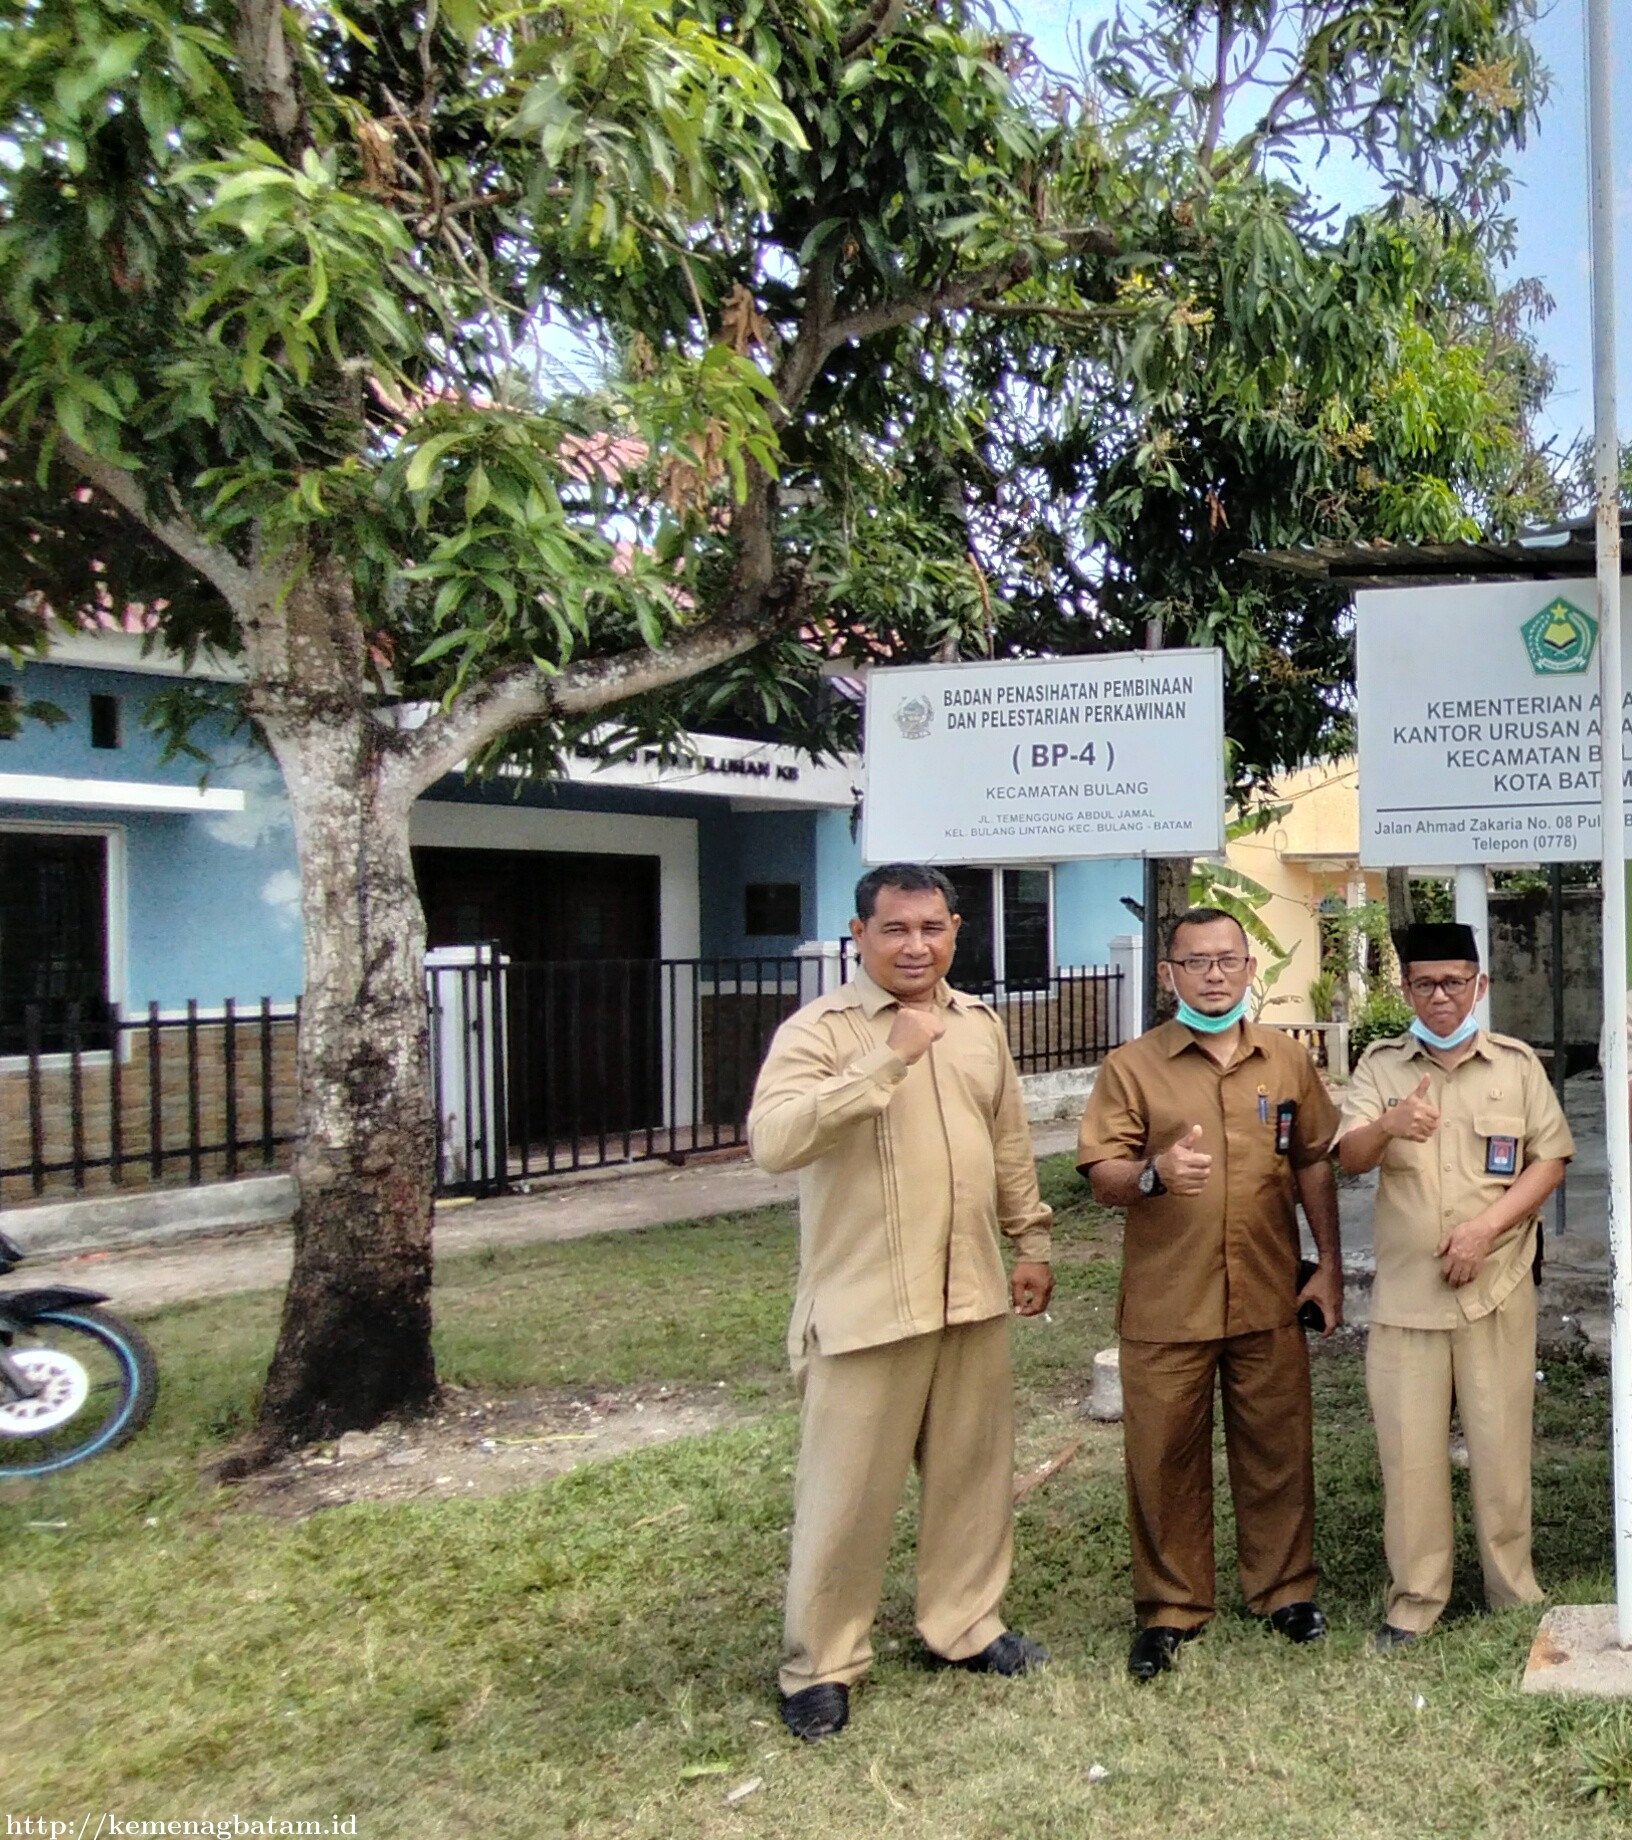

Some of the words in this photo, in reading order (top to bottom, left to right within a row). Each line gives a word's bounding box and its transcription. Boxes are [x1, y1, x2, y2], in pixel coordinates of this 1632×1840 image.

[943, 688, 992, 707] BADAN
[996, 682, 1099, 705] PENASIHATAN
[1103, 676, 1194, 699] PEMBINAAN
[947, 712, 977, 730] DAN
[981, 706, 1081, 728] PELESTARIAN
[1084, 701, 1187, 724] PERKAWINAN
[1426, 694, 1582, 720] KEMENTERIAN
[1392, 723, 1482, 745] KANTOR
[1488, 718, 1581, 741] URUSAN
[1446, 743, 1581, 768] KECAMATAN
[985, 784, 1080, 801] KECAMATAN
[1083, 781, 1149, 797] BULANG
[1493, 770, 1552, 792] KOTA
[996, 812, 1074, 824] TEMENGGUNG
[1076, 810, 1115, 821] ABDUL
[1117, 809, 1156, 819] JAMAL
[1374, 822, 1412, 836] Jalan
[1415, 819, 1466, 834] Ahmad
[1469, 817, 1523, 832] Zakaria
[1527, 816, 1552, 831] No.
[1555, 815, 1573, 829] 08
[970, 826, 1016, 838] BULANG
[1018, 824, 1065, 836] LINTANG
[1097, 822, 1144, 833] BULANG
[1153, 820, 1193, 831] BATAM
[1472, 836, 1530, 854] Telepon
[1533, 834, 1578, 852] (0778)
